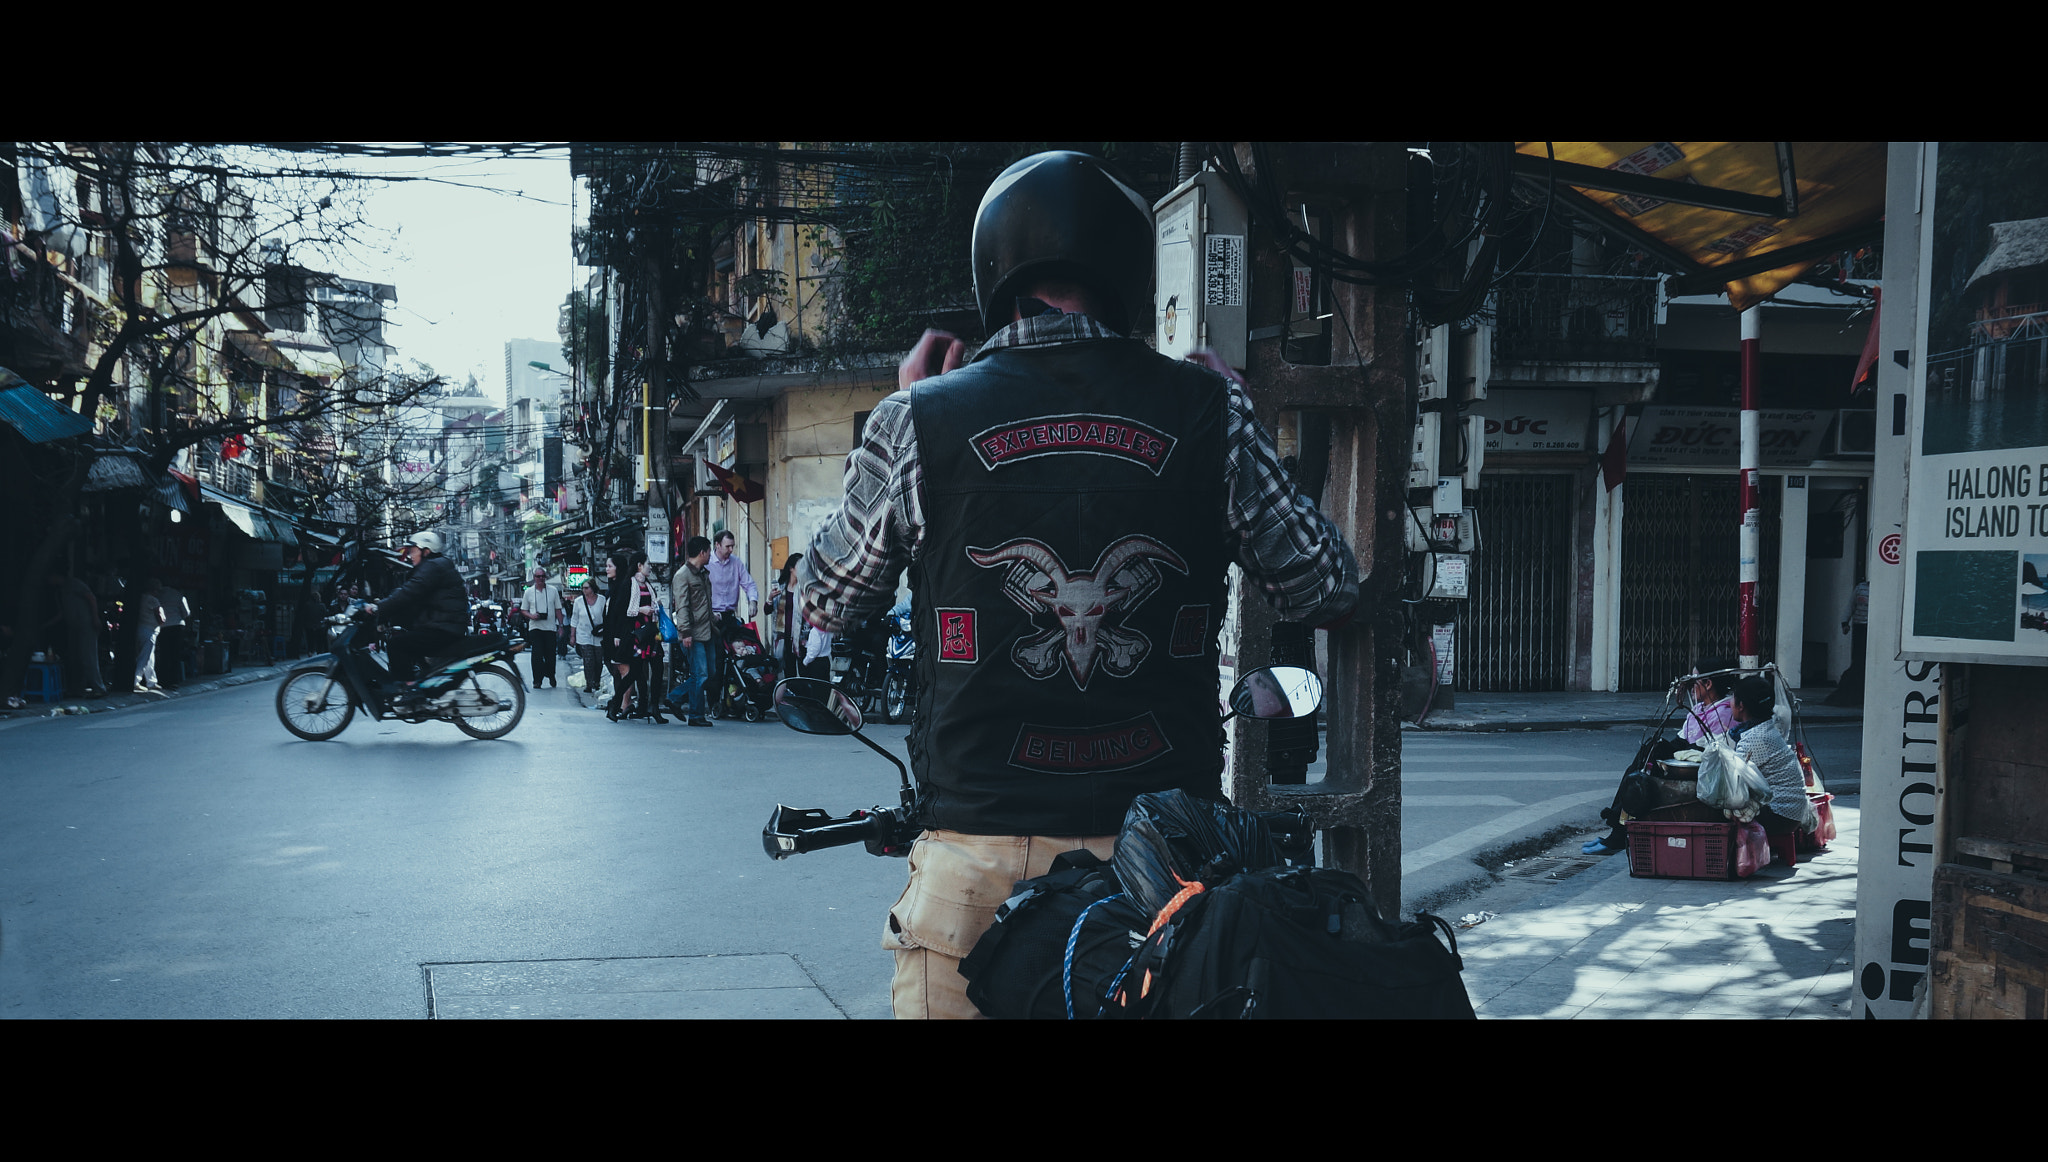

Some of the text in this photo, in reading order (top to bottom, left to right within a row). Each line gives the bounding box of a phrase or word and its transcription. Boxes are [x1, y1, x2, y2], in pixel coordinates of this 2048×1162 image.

[983, 423, 1163, 460] EXPENDABLES
[1947, 465, 2031, 500] HALONG
[1945, 504, 2020, 538] ISLAND
[1026, 727, 1152, 763] BEIJING
[1897, 660, 1941, 868] TOURS
